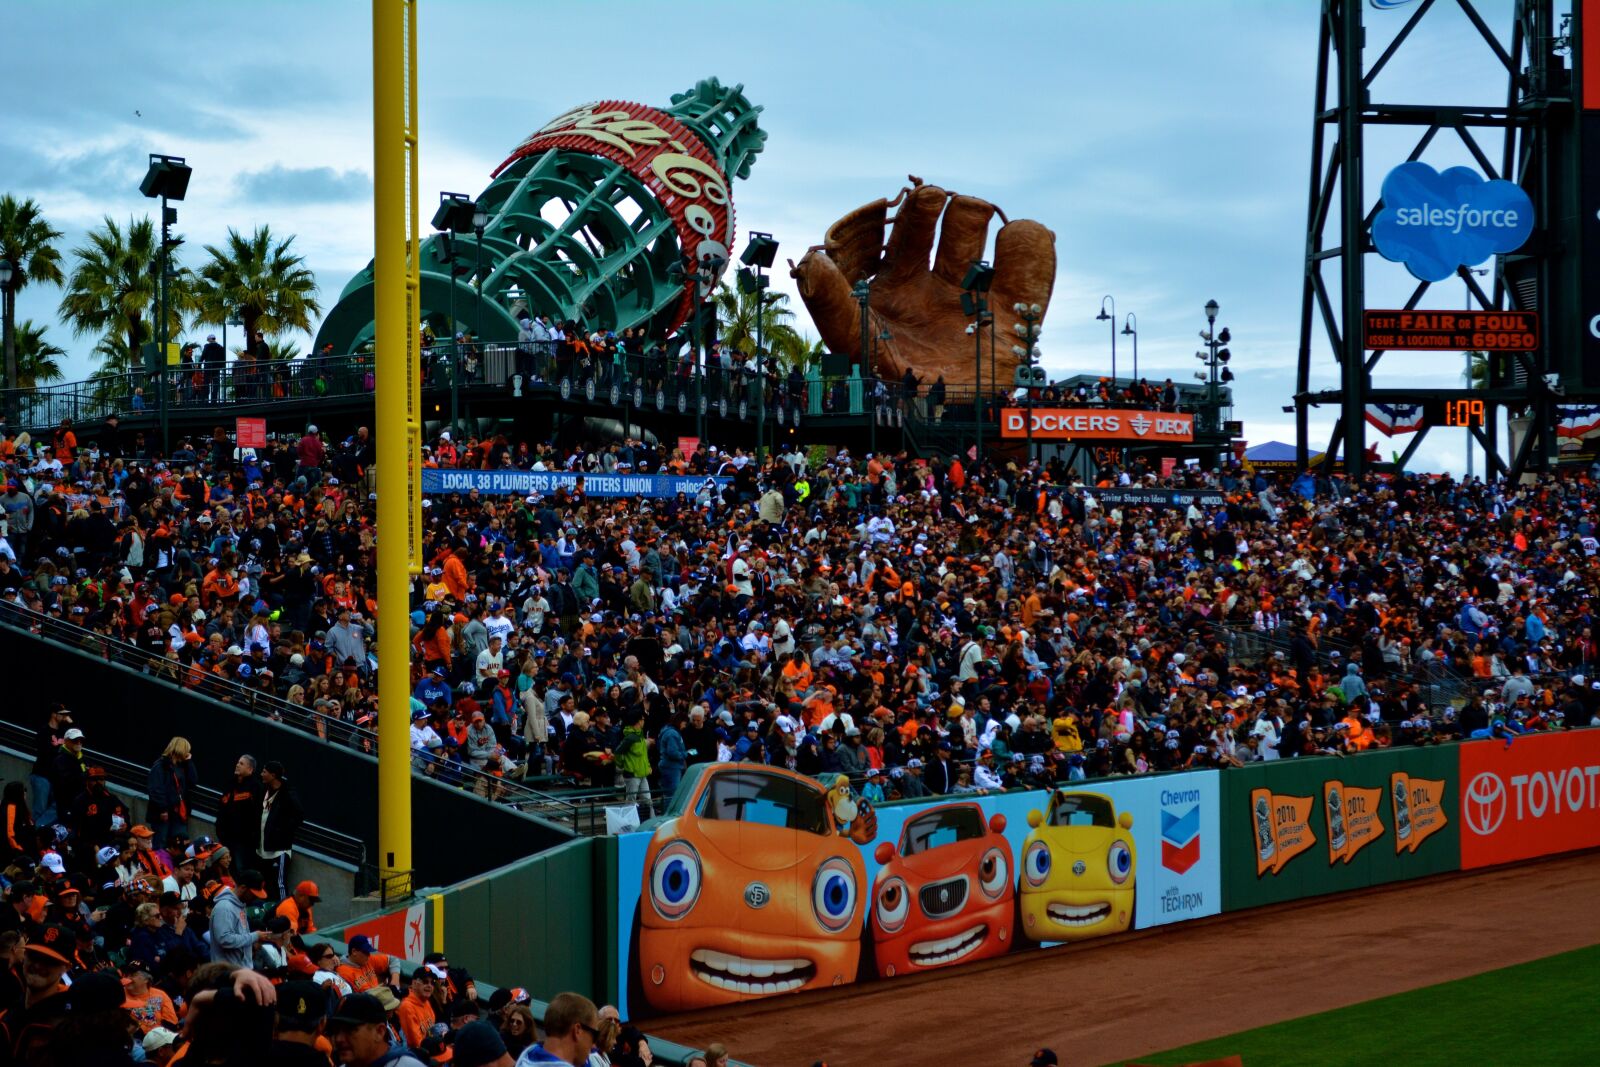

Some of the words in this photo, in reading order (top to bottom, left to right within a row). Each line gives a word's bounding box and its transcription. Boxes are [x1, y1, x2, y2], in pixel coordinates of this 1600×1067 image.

[1396, 203, 1518, 234] salesforce
[1369, 317, 1399, 329] TEXT:
[1401, 315, 1456, 330] FAIR
[1475, 315, 1527, 330] FOUL
[1369, 335, 1394, 345] ISSUE
[1407, 335, 1450, 346] LOCATION
[1472, 333, 1535, 347] 69050
[1446, 400, 1484, 426] 1:09
[1008, 415, 1120, 431] DOCKERS
[1156, 418, 1191, 434] DECK
[443, 473, 473, 489] LOCAL
[477, 475, 491, 490] 38
[493, 475, 549, 492] PLUMBERS
[623, 477, 652, 493] UNION
[1161, 789, 1200, 806] Chevron
[1413, 789, 1430, 807] 2014
[1511, 765, 1600, 820] TOYOT
[1277, 805, 1296, 826] 2010
[1347, 797, 1365, 816] 2012
[1166, 886, 1178, 897] with
[1161, 892, 1203, 913] TECHRON
